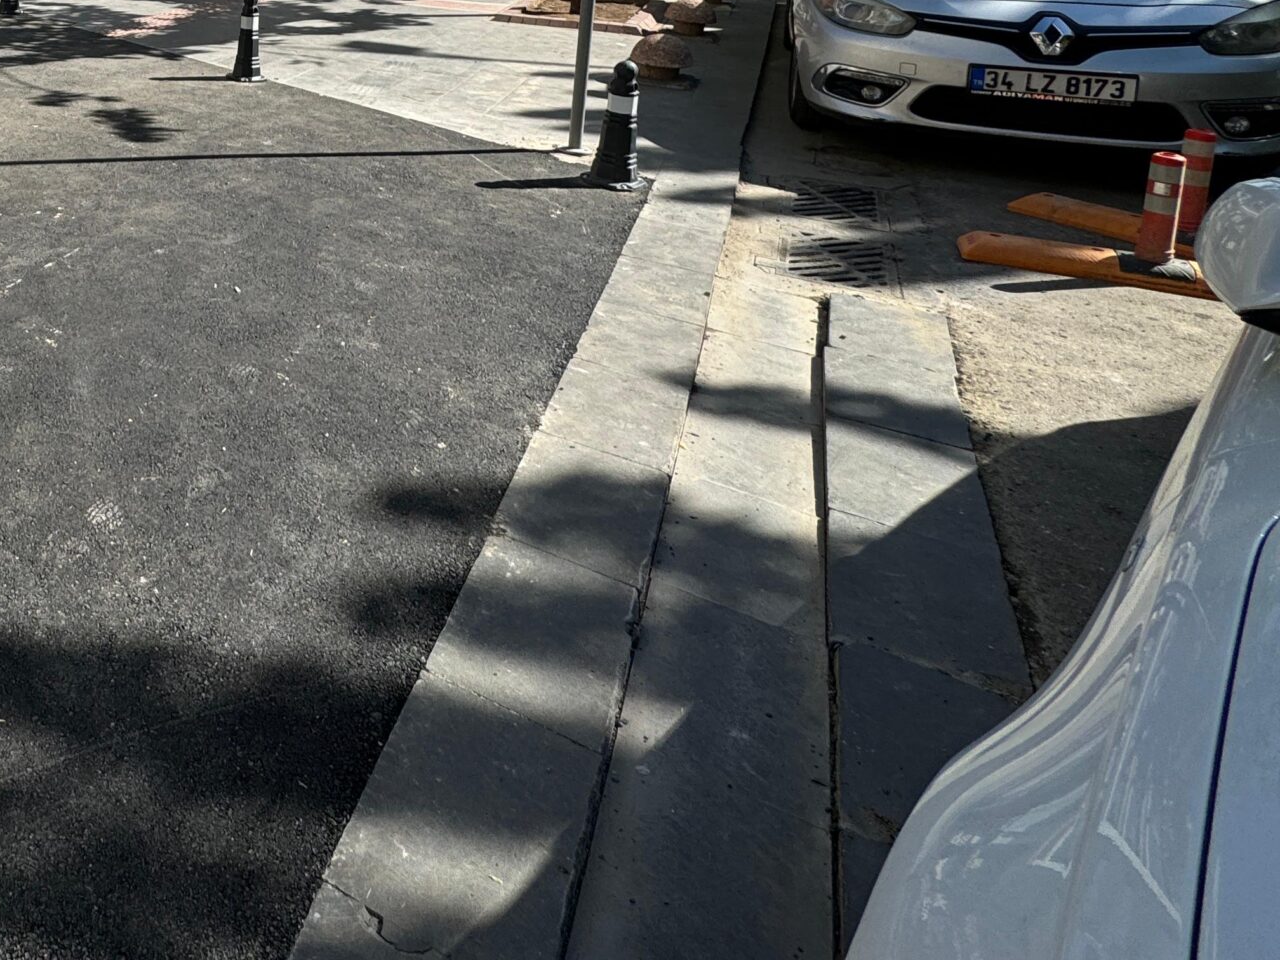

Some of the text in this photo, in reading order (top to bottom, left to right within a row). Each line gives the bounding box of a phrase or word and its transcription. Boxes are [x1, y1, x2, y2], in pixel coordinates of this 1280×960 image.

[985, 70, 1126, 99] 34 LZ 8173
[992, 90, 1064, 102] ADIYAMAN
